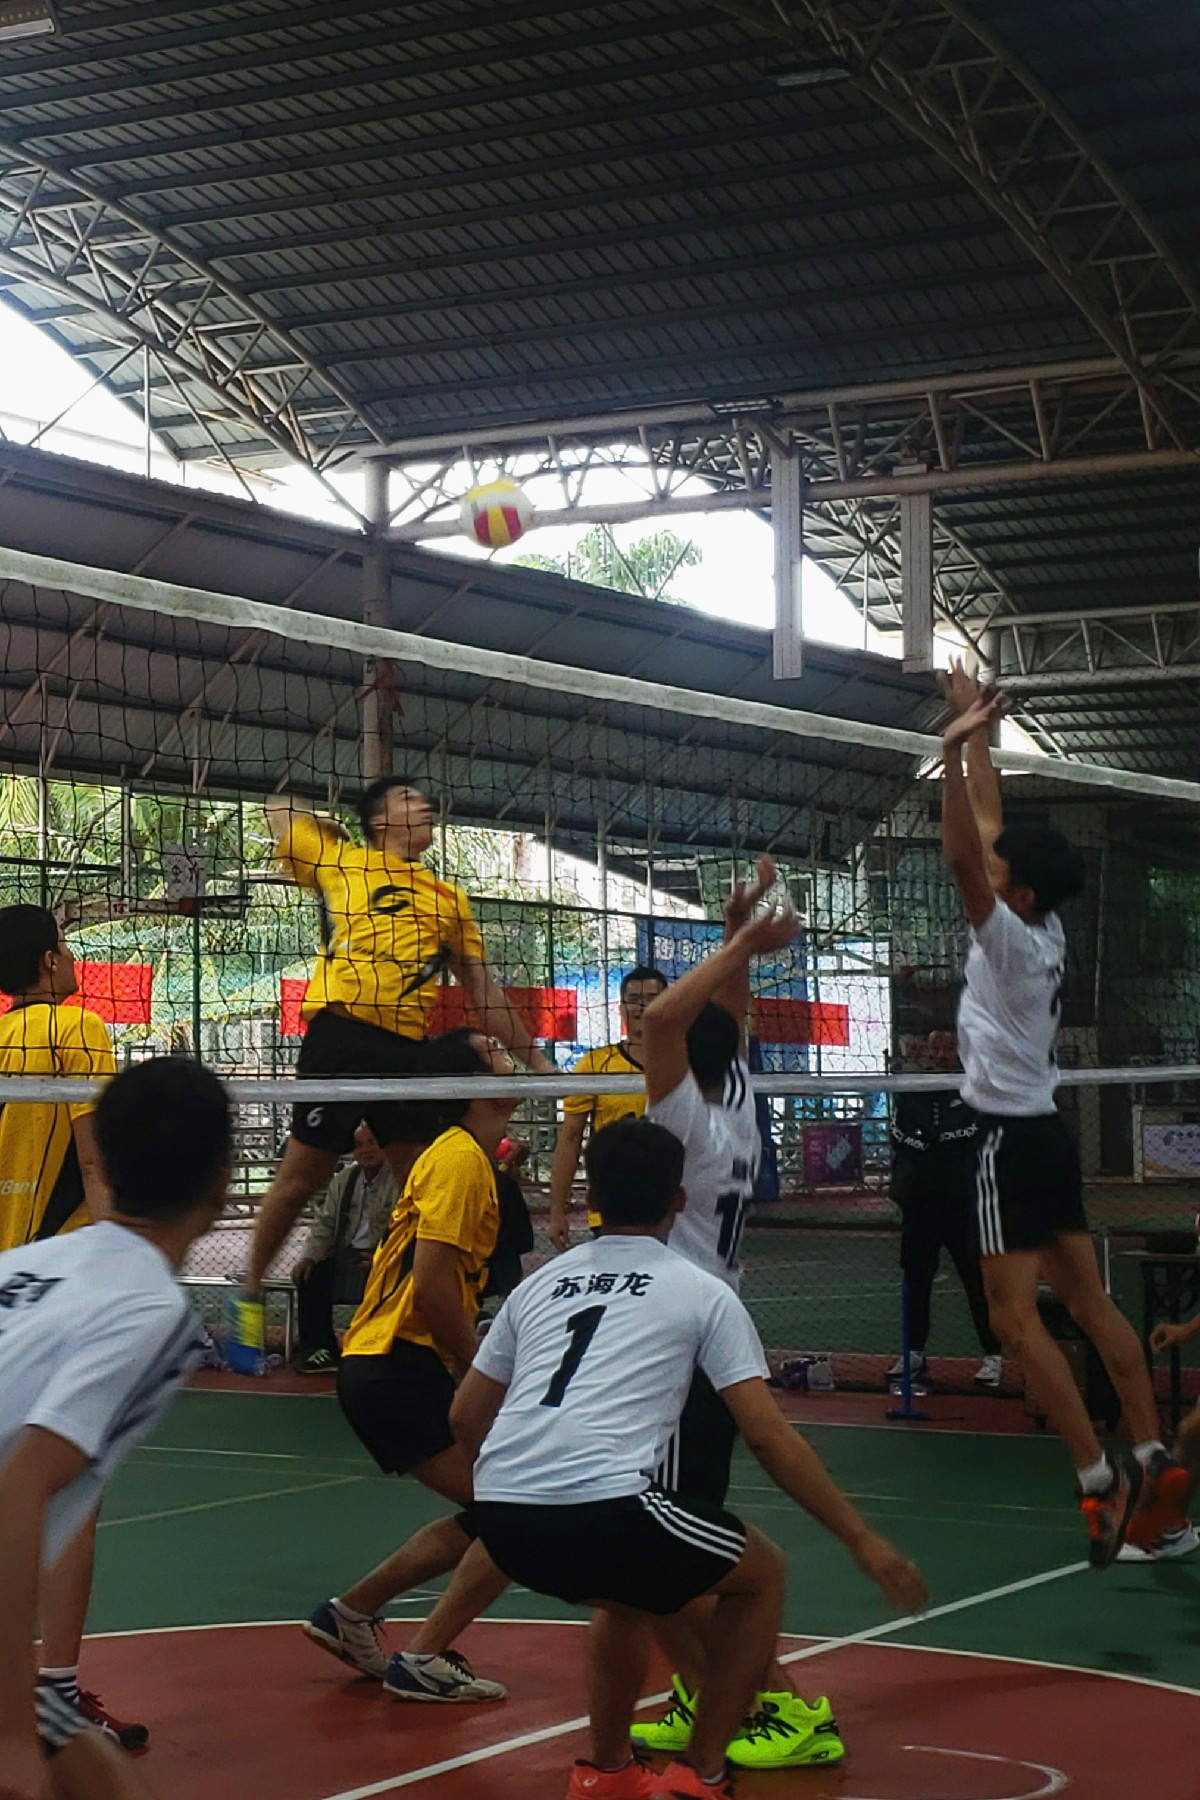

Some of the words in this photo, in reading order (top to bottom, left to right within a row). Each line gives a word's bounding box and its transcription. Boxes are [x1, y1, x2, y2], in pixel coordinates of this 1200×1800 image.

[306, 1107, 325, 1128] 6
[551, 1271, 655, 1300] 苏海龙
[539, 1304, 608, 1408] 1
